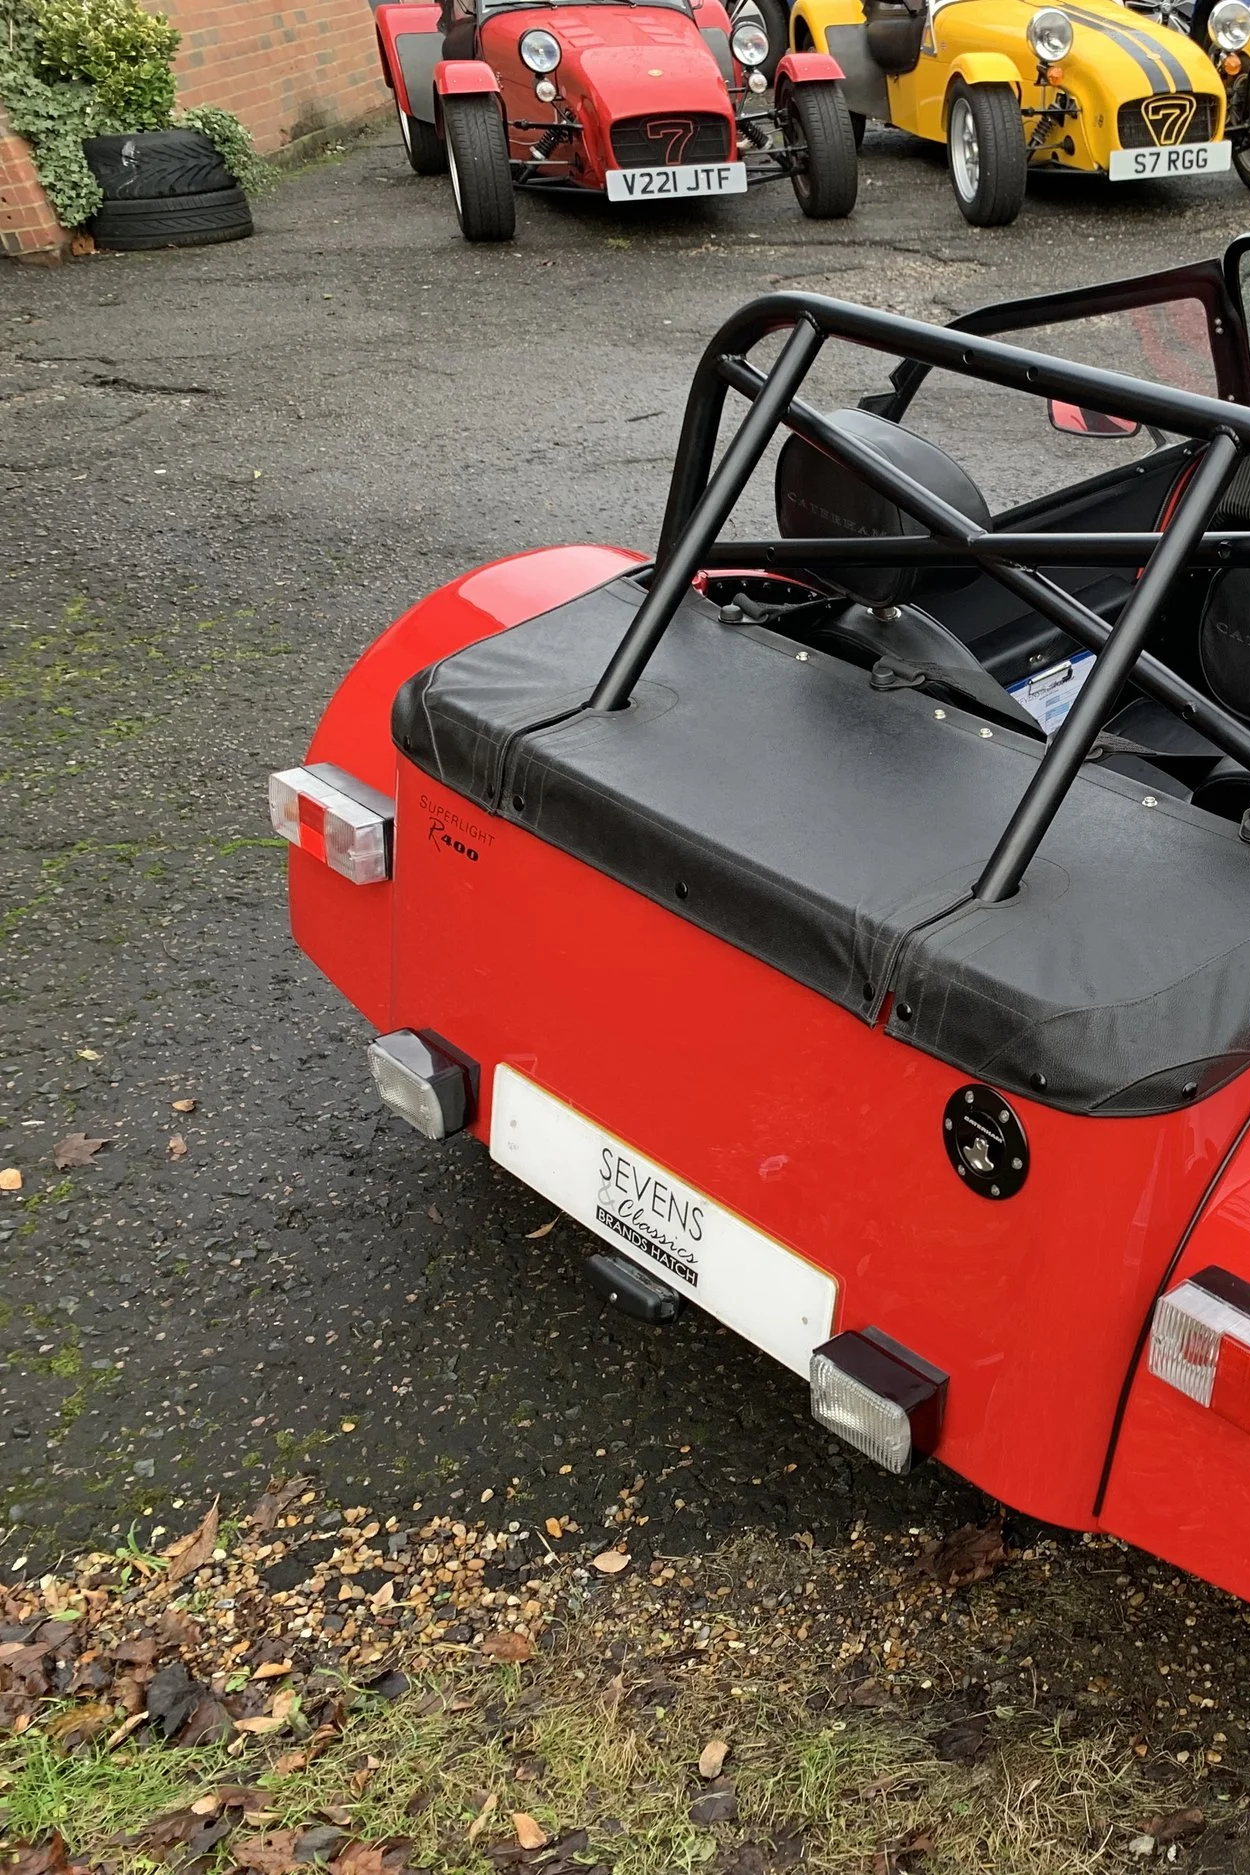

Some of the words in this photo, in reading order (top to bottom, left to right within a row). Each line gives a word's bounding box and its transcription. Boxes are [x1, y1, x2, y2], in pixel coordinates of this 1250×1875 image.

[646, 119, 694, 165] 7
[1148, 100, 1190, 145] 7
[622, 171, 678, 196] V221
[686, 167, 731, 191] JTF
[1134, 152, 1161, 174] S7
[1167, 148, 1208, 171] RGG
[419, 794, 495, 847] SUPERLIGHT
[428, 816, 479, 862] R400
[599, 1147, 704, 1242] SEVENS
[597, 1178, 616, 1212] &
[618, 1199, 699, 1264] Classics
[598, 1207, 648, 1252] BRANDS
[650, 1244, 696, 1285] HATCH
